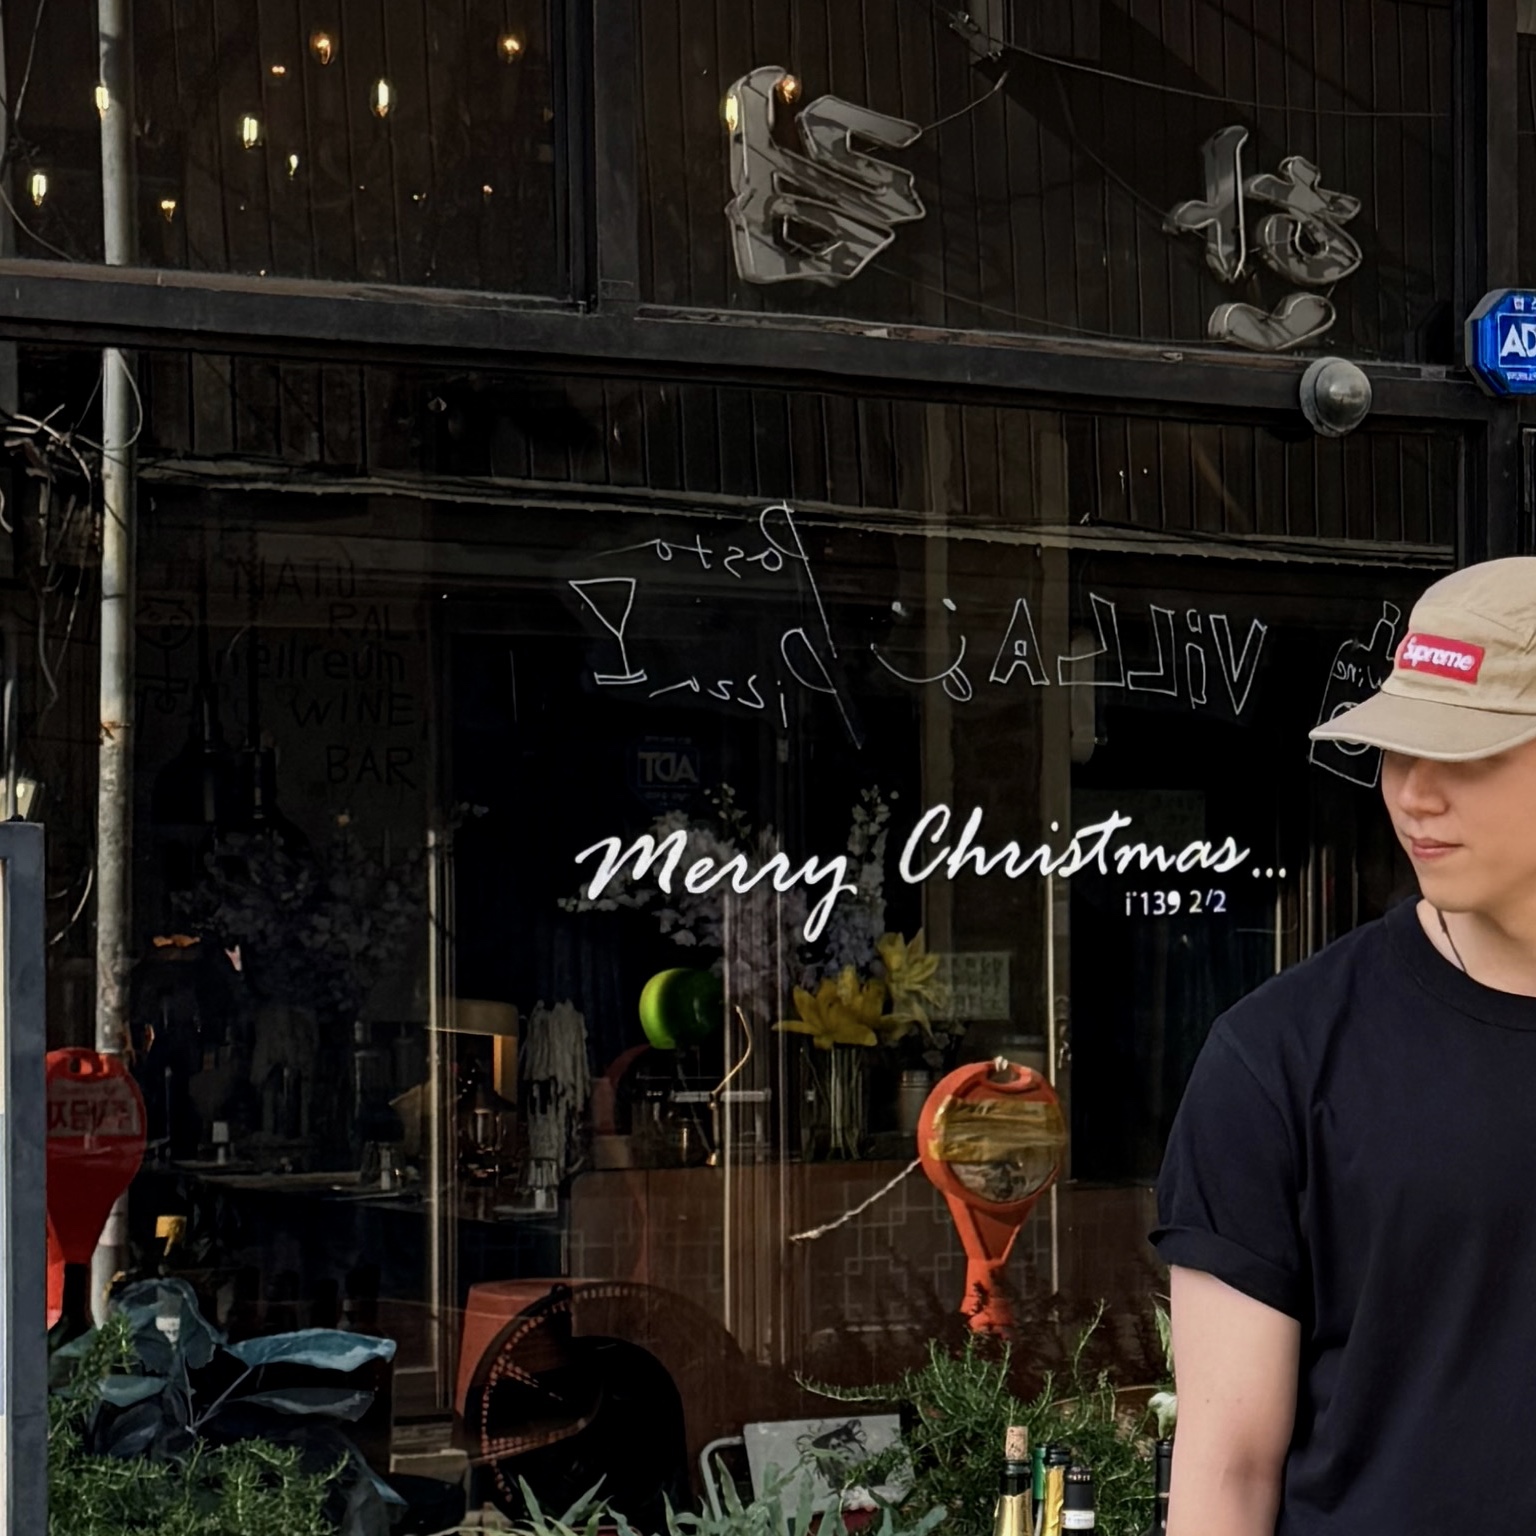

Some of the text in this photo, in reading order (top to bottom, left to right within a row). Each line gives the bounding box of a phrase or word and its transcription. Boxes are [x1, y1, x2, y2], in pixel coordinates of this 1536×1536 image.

[290, 689, 415, 728] WINE
[325, 745, 417, 790] BAR
[575, 828, 858, 943] Merry
